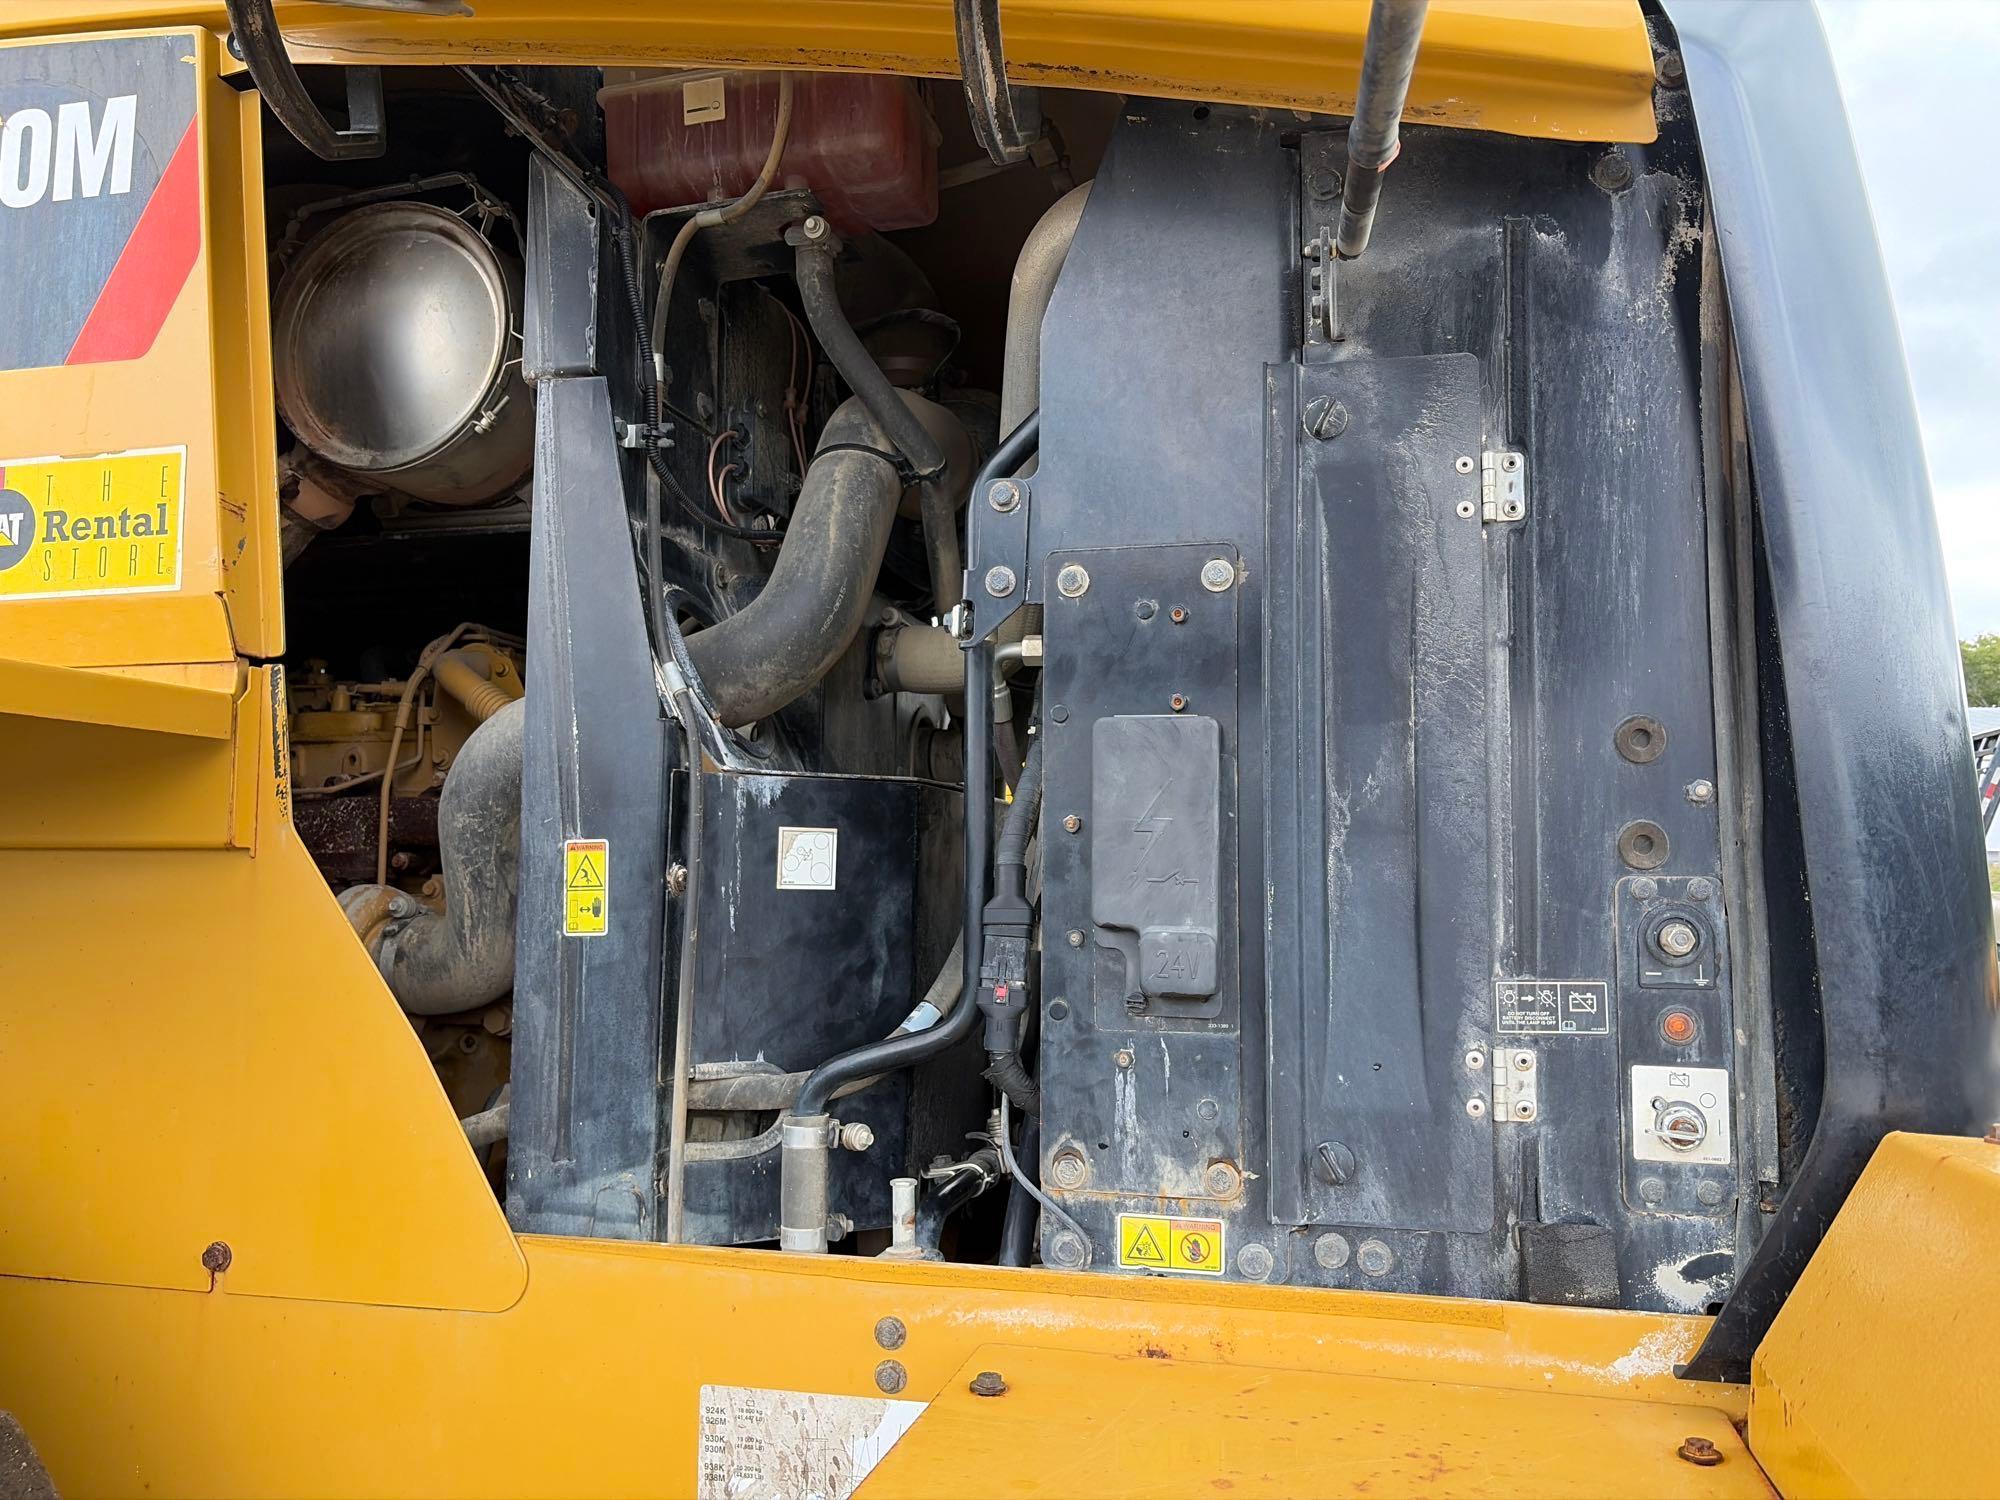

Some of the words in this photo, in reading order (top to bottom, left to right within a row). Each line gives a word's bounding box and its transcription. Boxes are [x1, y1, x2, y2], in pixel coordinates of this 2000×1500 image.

[46, 466, 168, 505] THE
[42, 502, 168, 543] Rental
[43, 543, 165, 582] STORE
[1154, 949, 1201, 980] 24V
[705, 1406, 726, 1415] 924K
[705, 1416, 727, 1425] 926M
[704, 1434, 725, 1443] 930K
[704, 1444, 726, 1454] 930M
[704, 1462, 725, 1472] 938K
[704, 1472, 726, 1482] 938M
